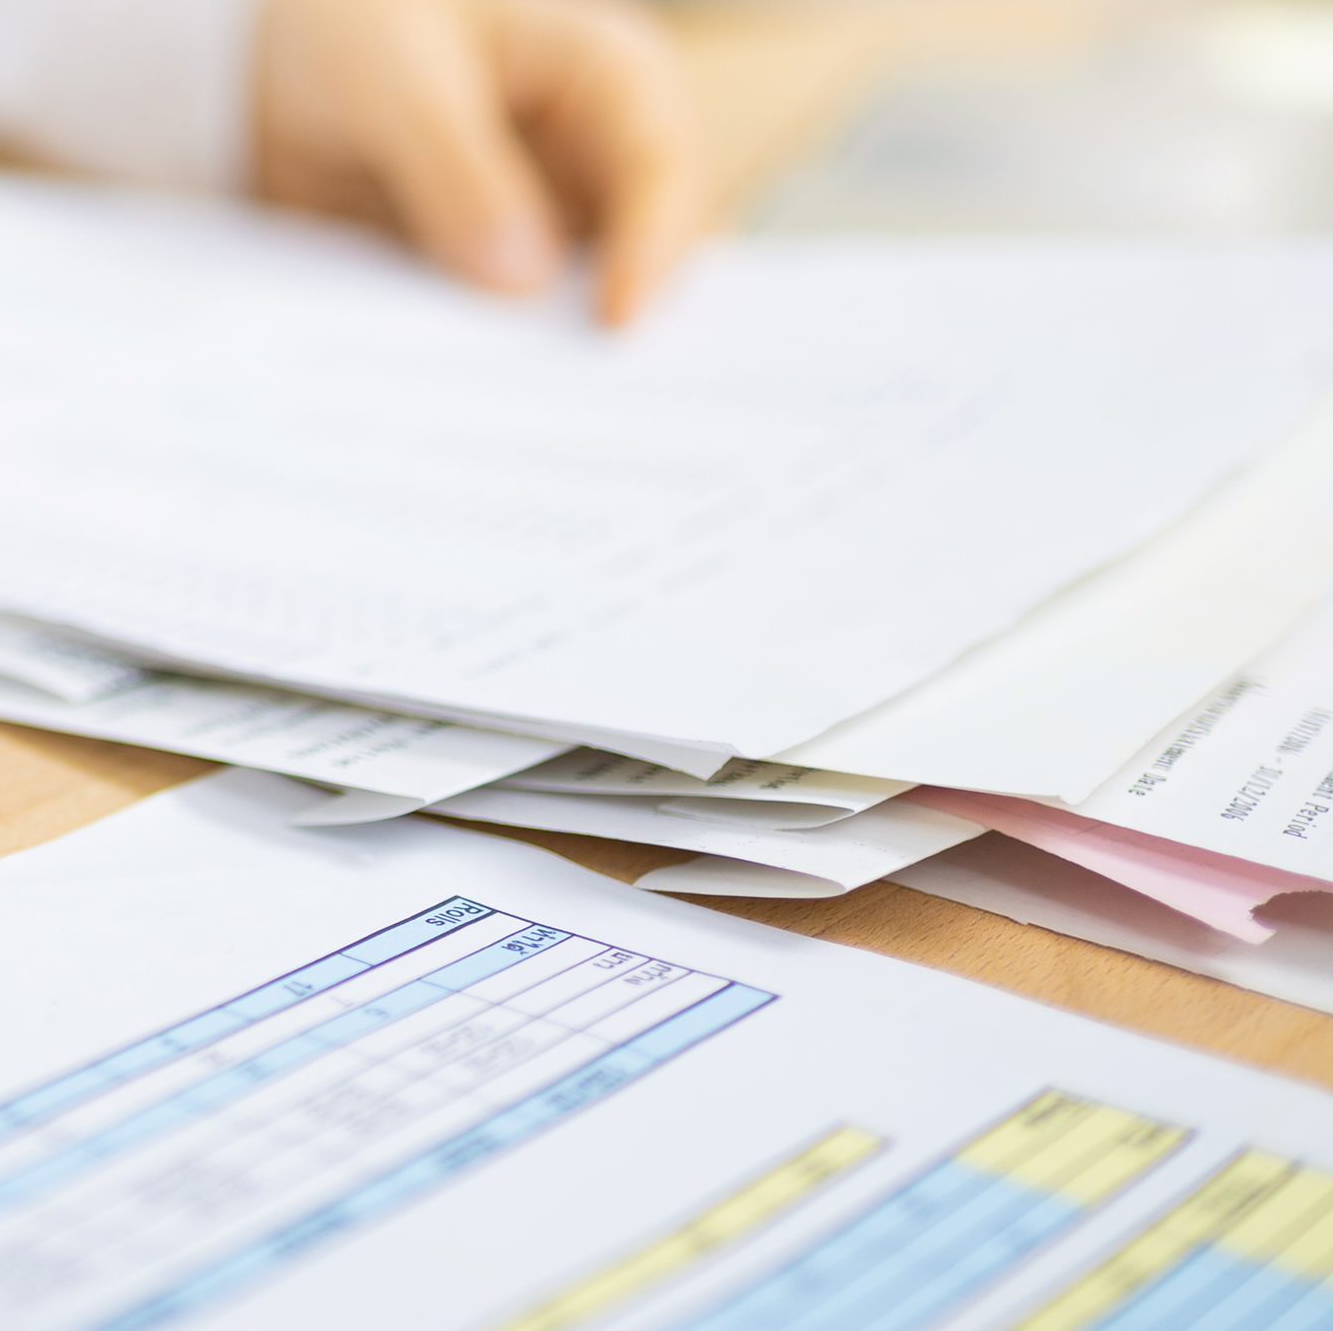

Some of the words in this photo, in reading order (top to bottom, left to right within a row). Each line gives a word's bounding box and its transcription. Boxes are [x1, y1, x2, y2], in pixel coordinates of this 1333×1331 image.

[1127, 772, 1167, 797] Date
[1282, 801, 1330, 840] Period
[424, 901, 485, 928] Rolls
[501, 927, 558, 956] ทำได้
[592, 951, 634, 970] ยาว
[624, 963, 673, 986] กว้าง
